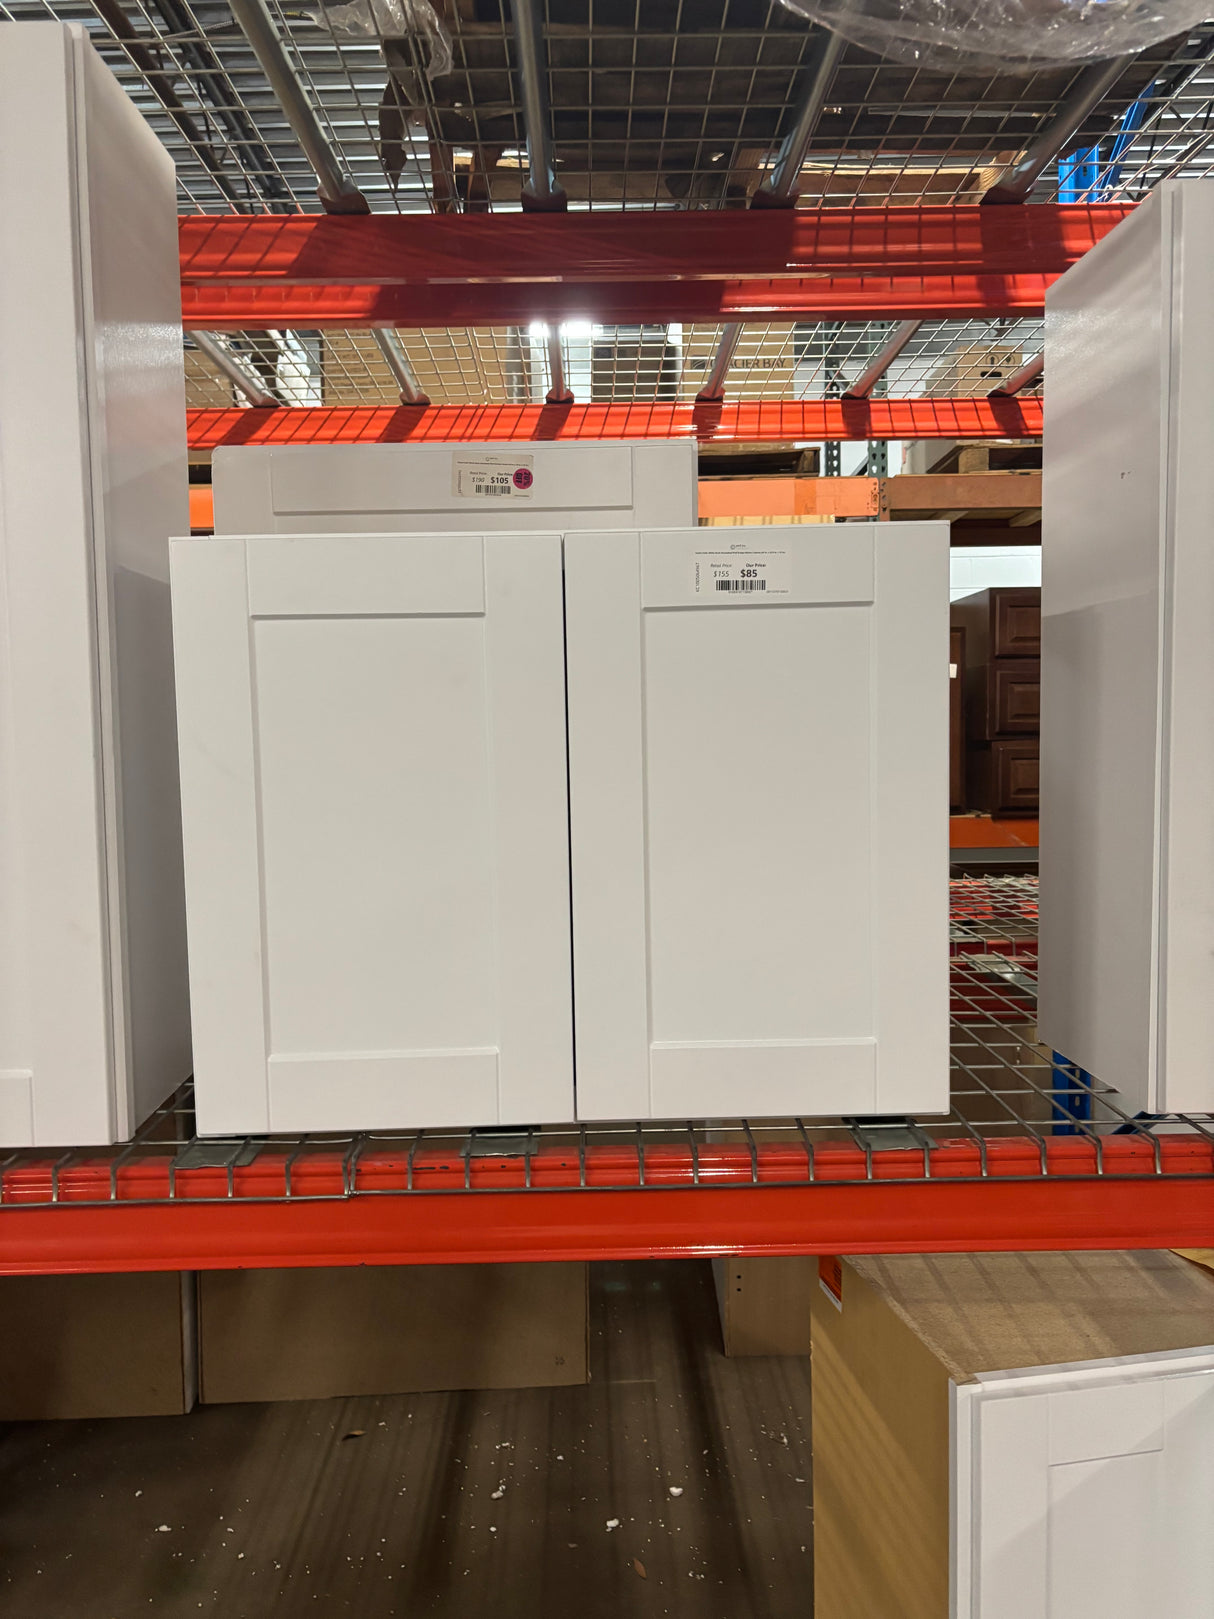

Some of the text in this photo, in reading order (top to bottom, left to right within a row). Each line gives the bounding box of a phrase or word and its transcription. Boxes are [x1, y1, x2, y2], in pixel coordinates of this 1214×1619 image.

[763, 358, 786, 369] BAY
[490, 476, 509, 485] $105
[713, 570, 730, 578] $155
[740, 569, 758, 578] $85
